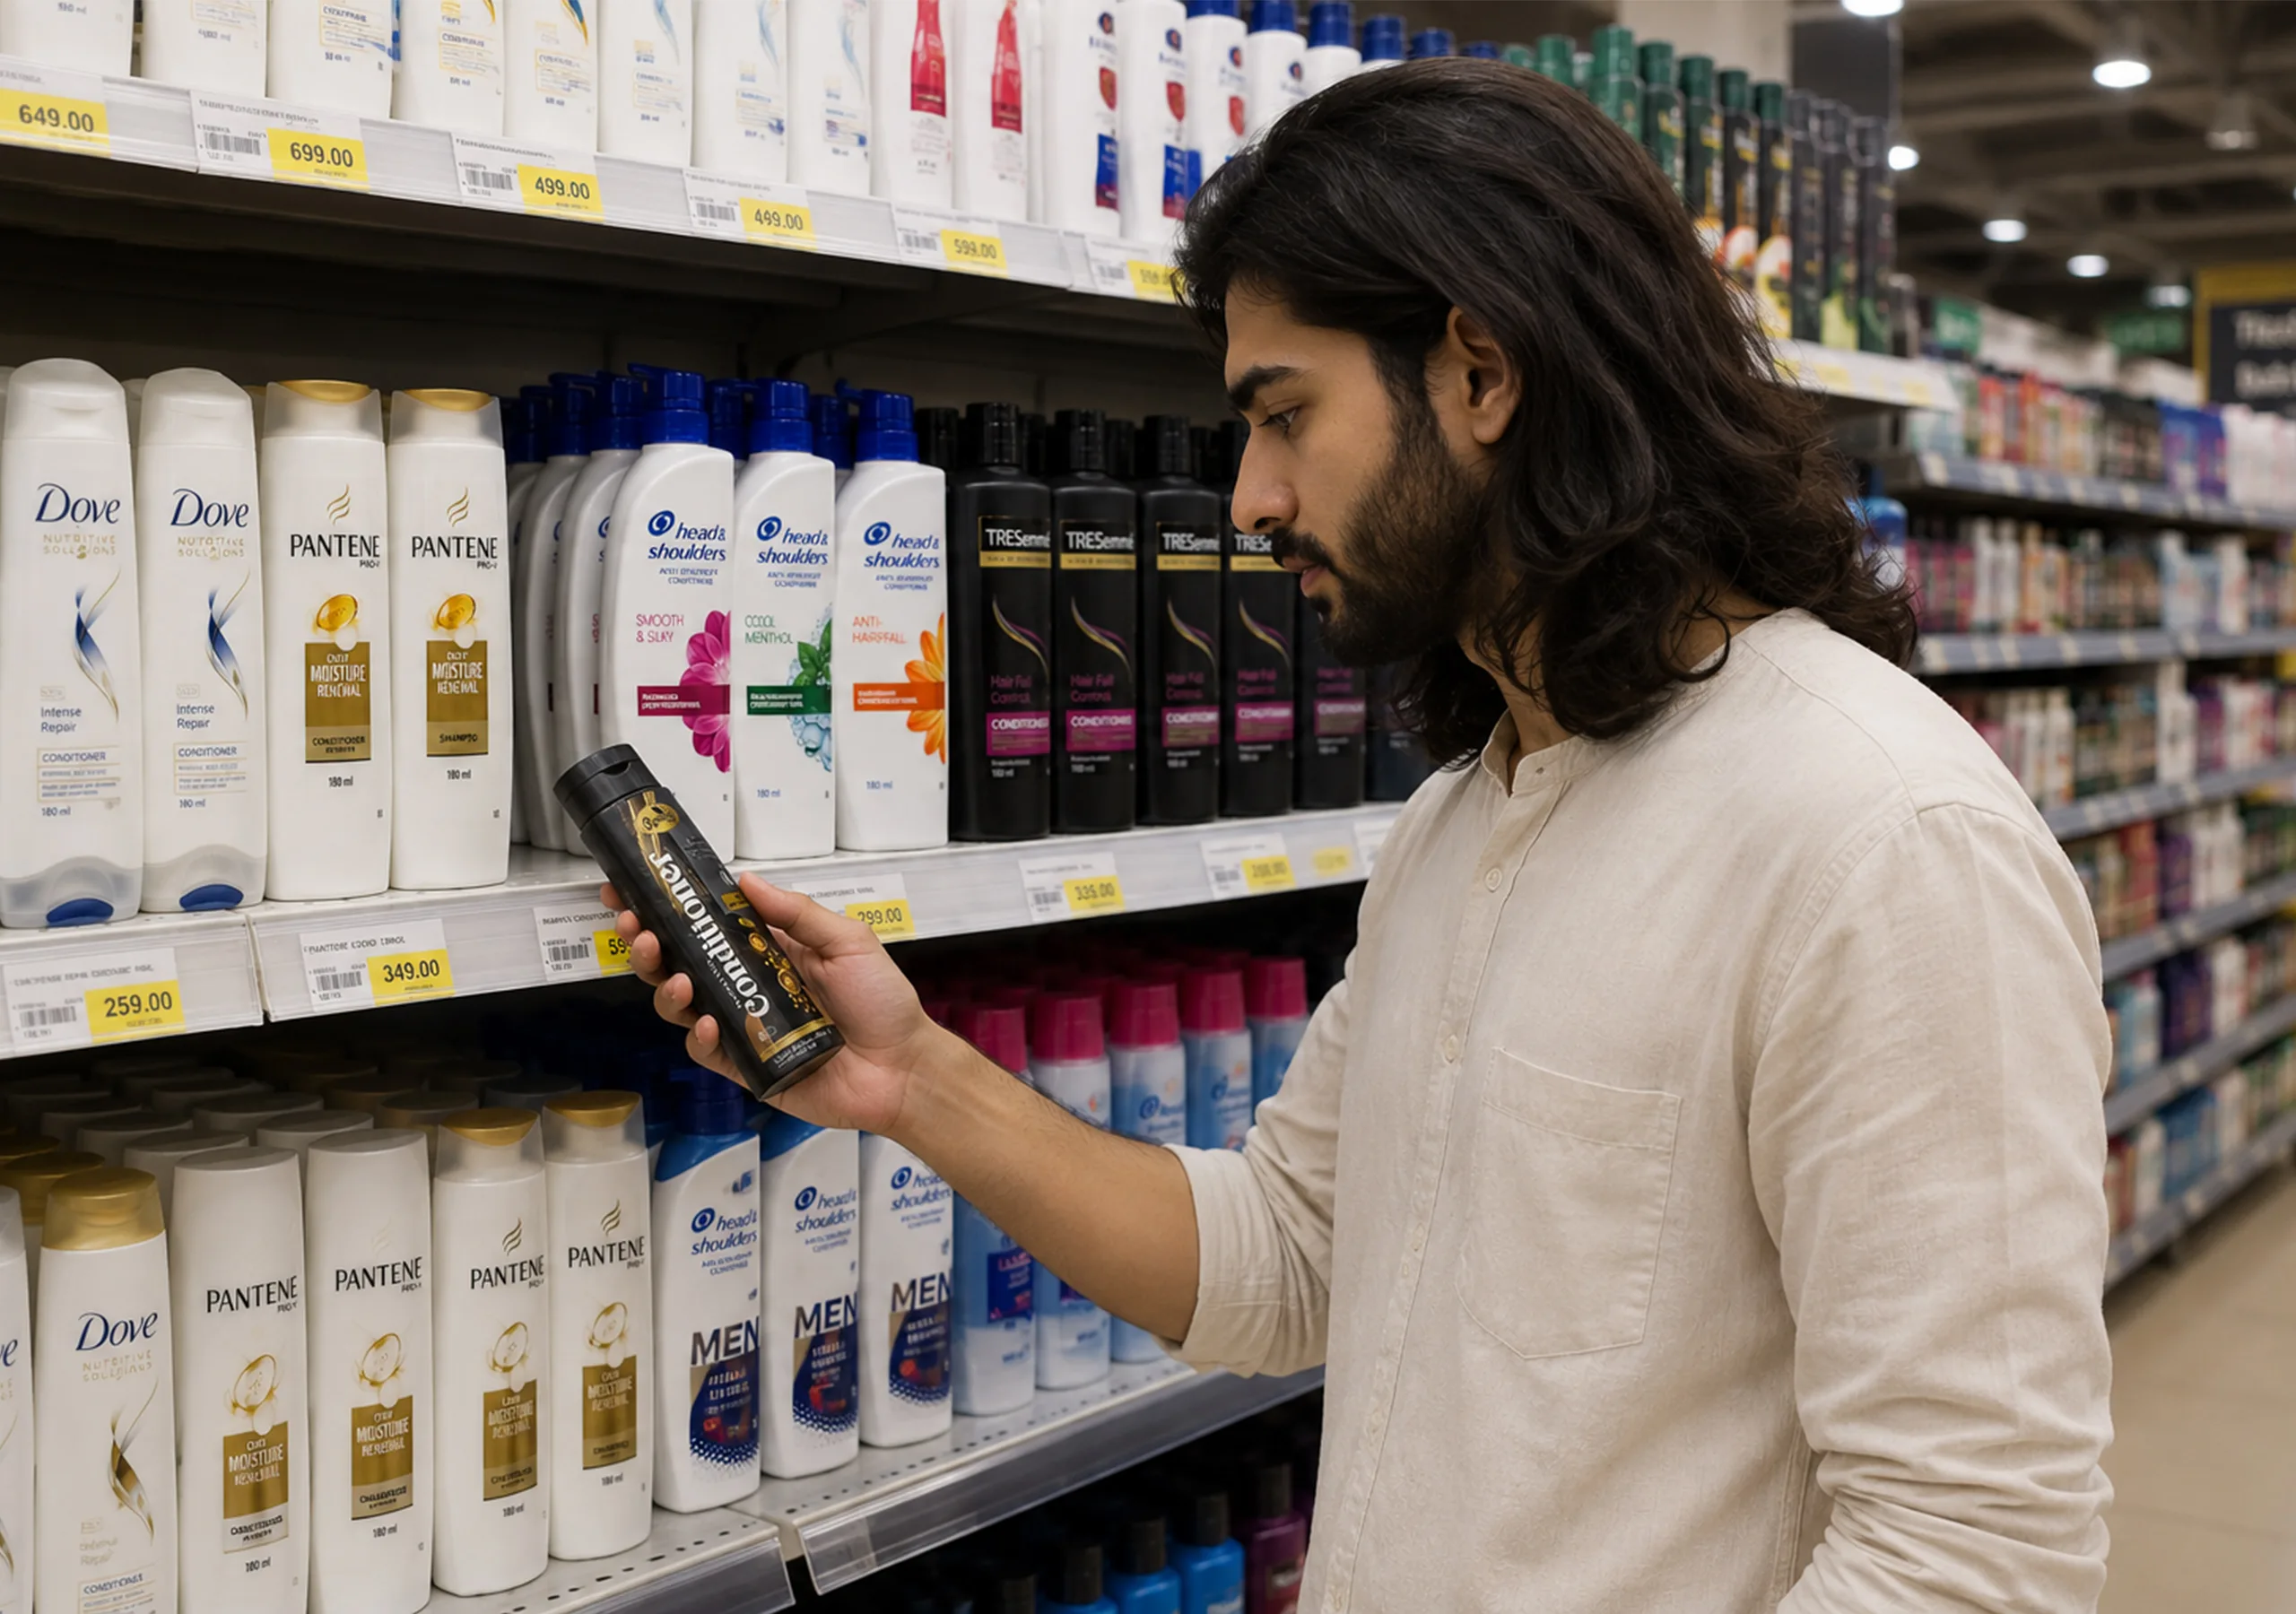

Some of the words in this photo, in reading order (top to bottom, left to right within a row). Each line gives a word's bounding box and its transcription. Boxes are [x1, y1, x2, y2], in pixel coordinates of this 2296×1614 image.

[19, 104, 94, 133] 649.00
[290, 142, 353, 168] 699.00
[535, 177, 590, 200] 499.00
[755, 208, 803, 230] 499.00
[35, 482, 121, 525] Dove
[170, 488, 249, 527] Dove
[675, 522, 726, 541] head&
[782, 528, 828, 546] head&
[891, 534, 939, 550] head&
[1234, 534, 1272, 552] TRESe
[291, 534, 379, 558] PANTENE
[412, 536, 498, 559] PANTENE
[648, 542, 726, 561] shoulders
[757, 547, 828, 565] shoulders
[864, 551, 940, 568] shoulders
[636, 630, 644, 643] &
[745, 632, 793, 644] MENTHOL
[40, 707, 82, 717] Intense
[40, 721, 76, 733] Repair
[177, 718, 210, 731] Repair
[608, 936, 631, 956] 59
[648, 853, 770, 1018] Conditioner
[382, 959, 439, 983] 349.00
[104, 991, 172, 1018] 259.00
[569, 1236, 645, 1268] PANTENE
[691, 1230, 757, 1255] shoulders
[335, 1256, 422, 1292] PANTENE
[471, 1255, 544, 1289] PANTENE
[207, 1275, 298, 1313] PANTENE
[891, 1269, 952, 1313] MEN
[795, 1290, 858, 1340] MEN
[75, 1312, 158, 1351] Dove
[691, 1315, 760, 1366] MEN
